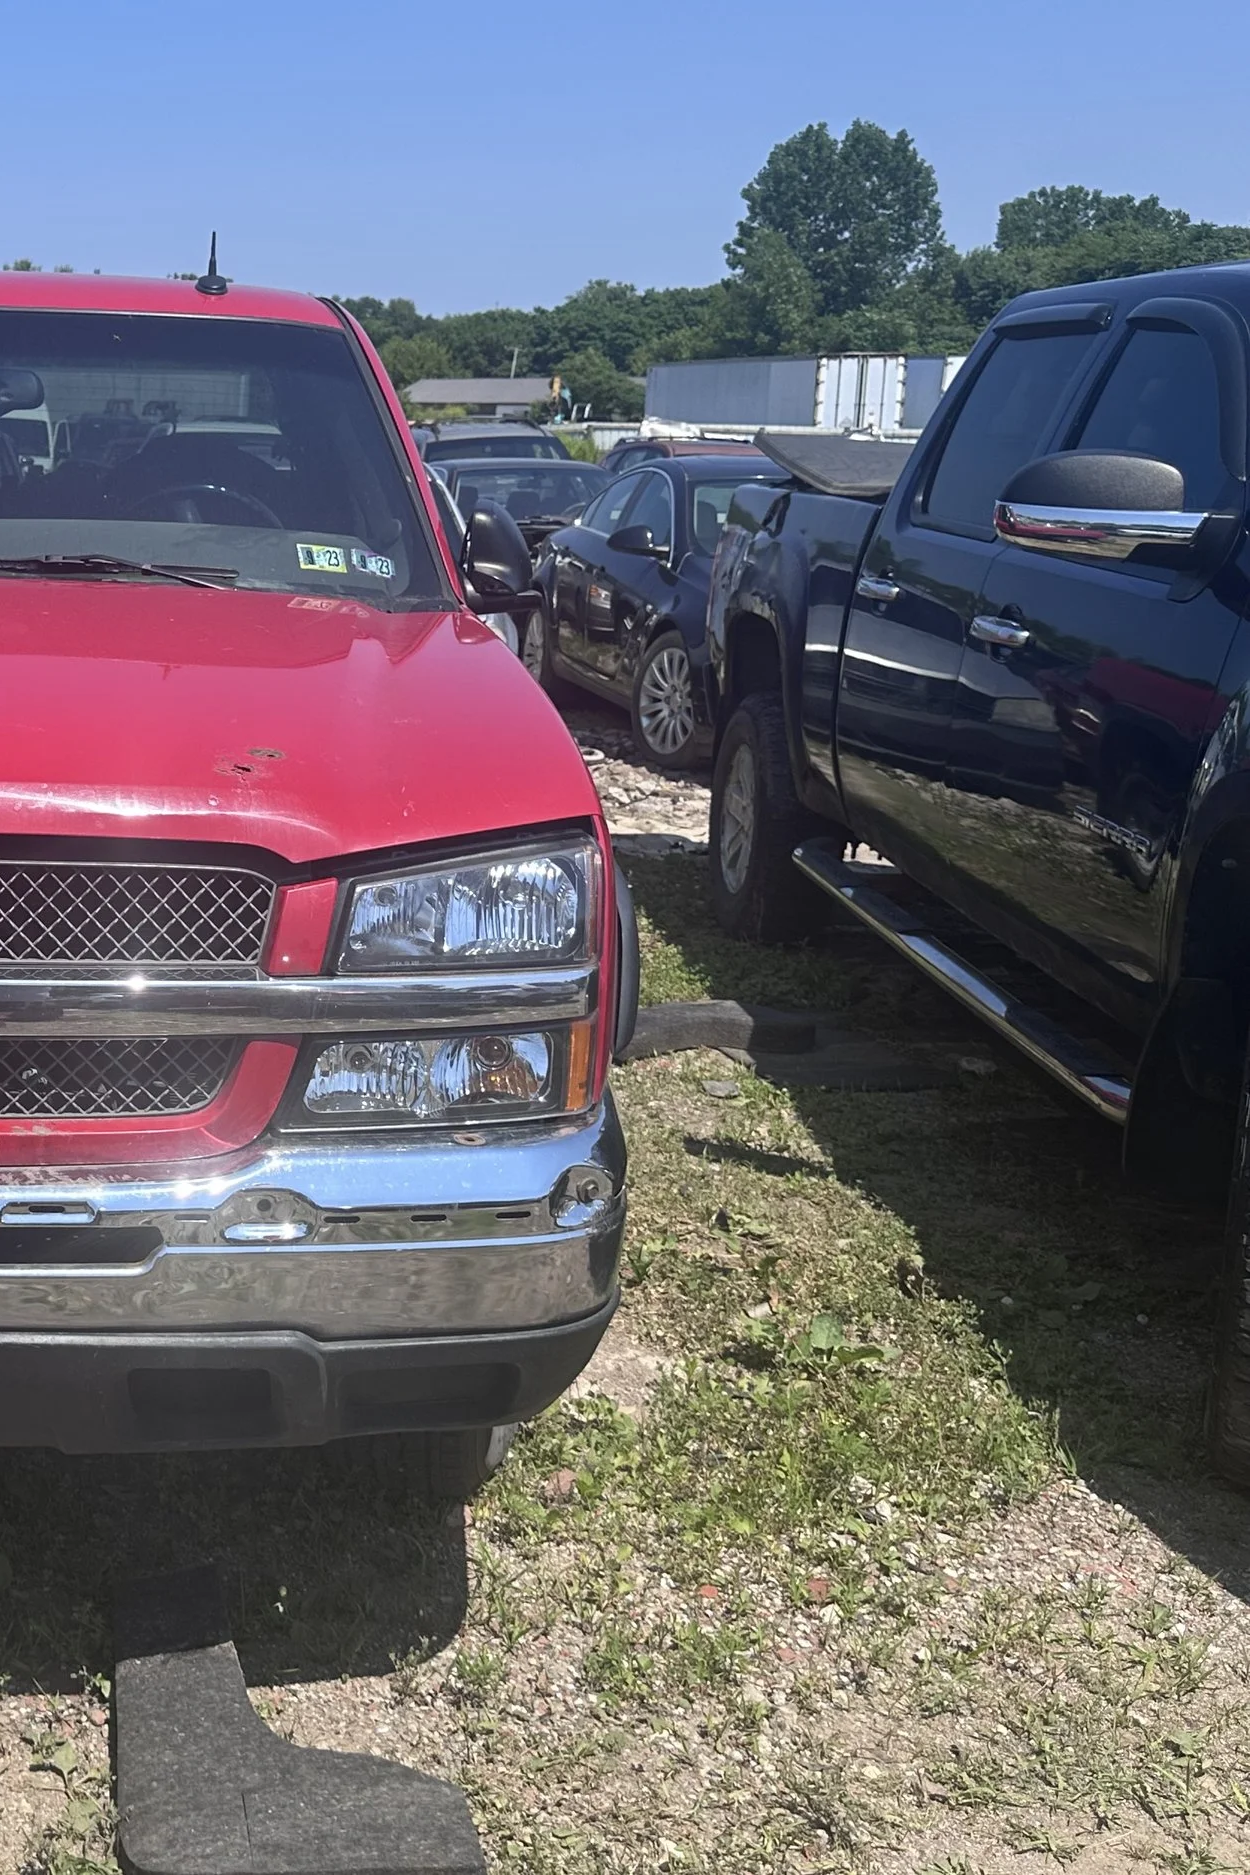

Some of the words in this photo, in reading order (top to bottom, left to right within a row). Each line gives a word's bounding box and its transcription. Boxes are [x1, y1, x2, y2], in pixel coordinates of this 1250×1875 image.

[326, 550, 340, 567] 23
[377, 558, 390, 575] 23
[1073, 805, 1150, 854] SIERRA
